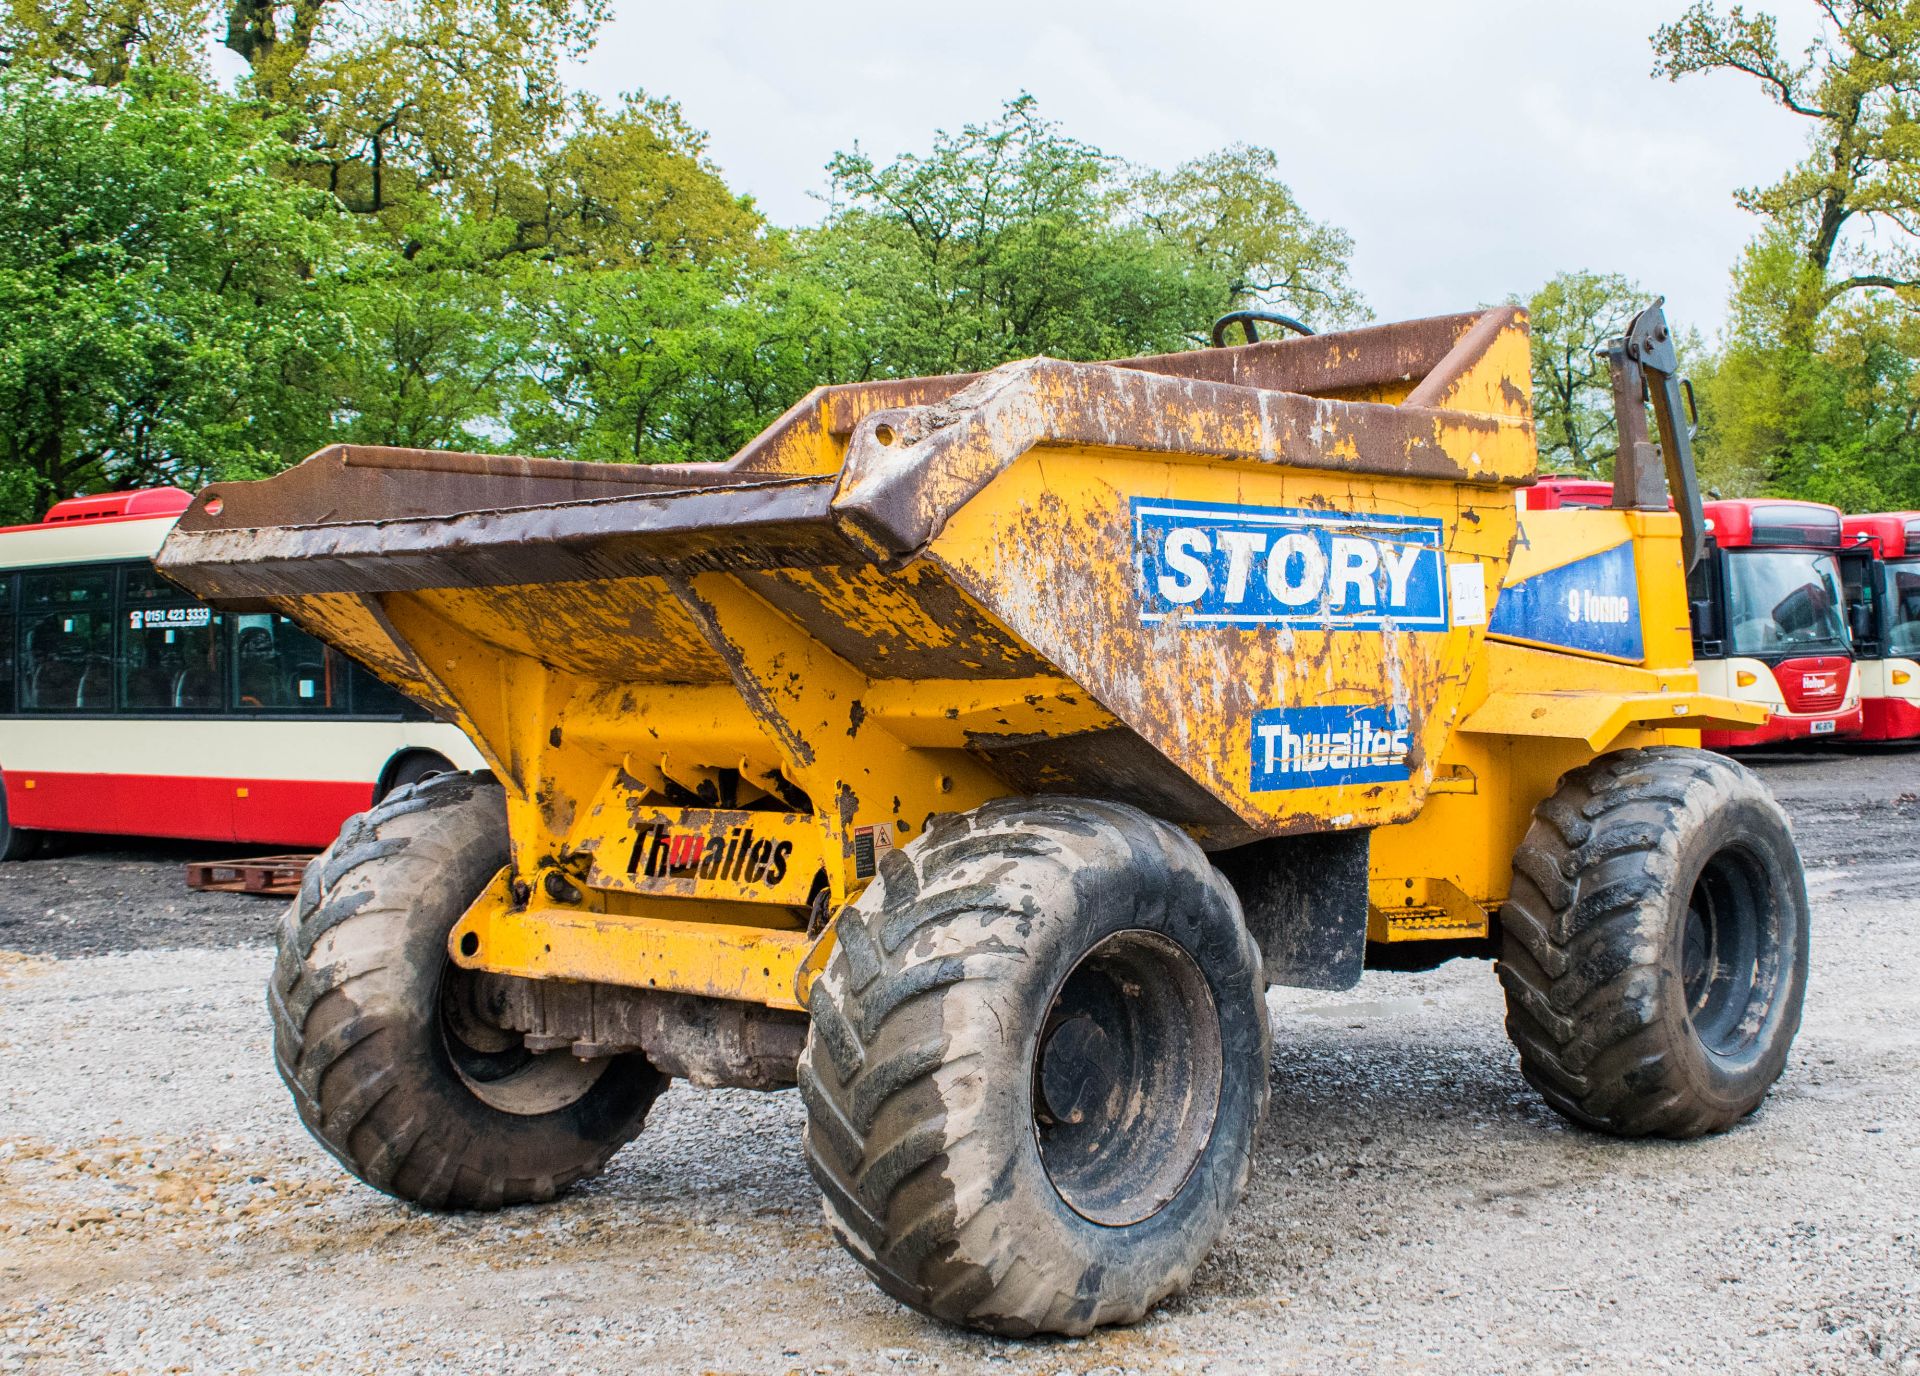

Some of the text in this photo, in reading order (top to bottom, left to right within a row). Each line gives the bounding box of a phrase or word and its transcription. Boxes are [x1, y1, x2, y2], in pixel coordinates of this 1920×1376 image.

[1157, 527, 1424, 607] STORY
[144, 608, 210, 621] 0151 423 3333
[1568, 588, 1629, 623] 9 tonne
[1257, 720, 1409, 775] Thwaites
[626, 822, 793, 886] Thwaites
